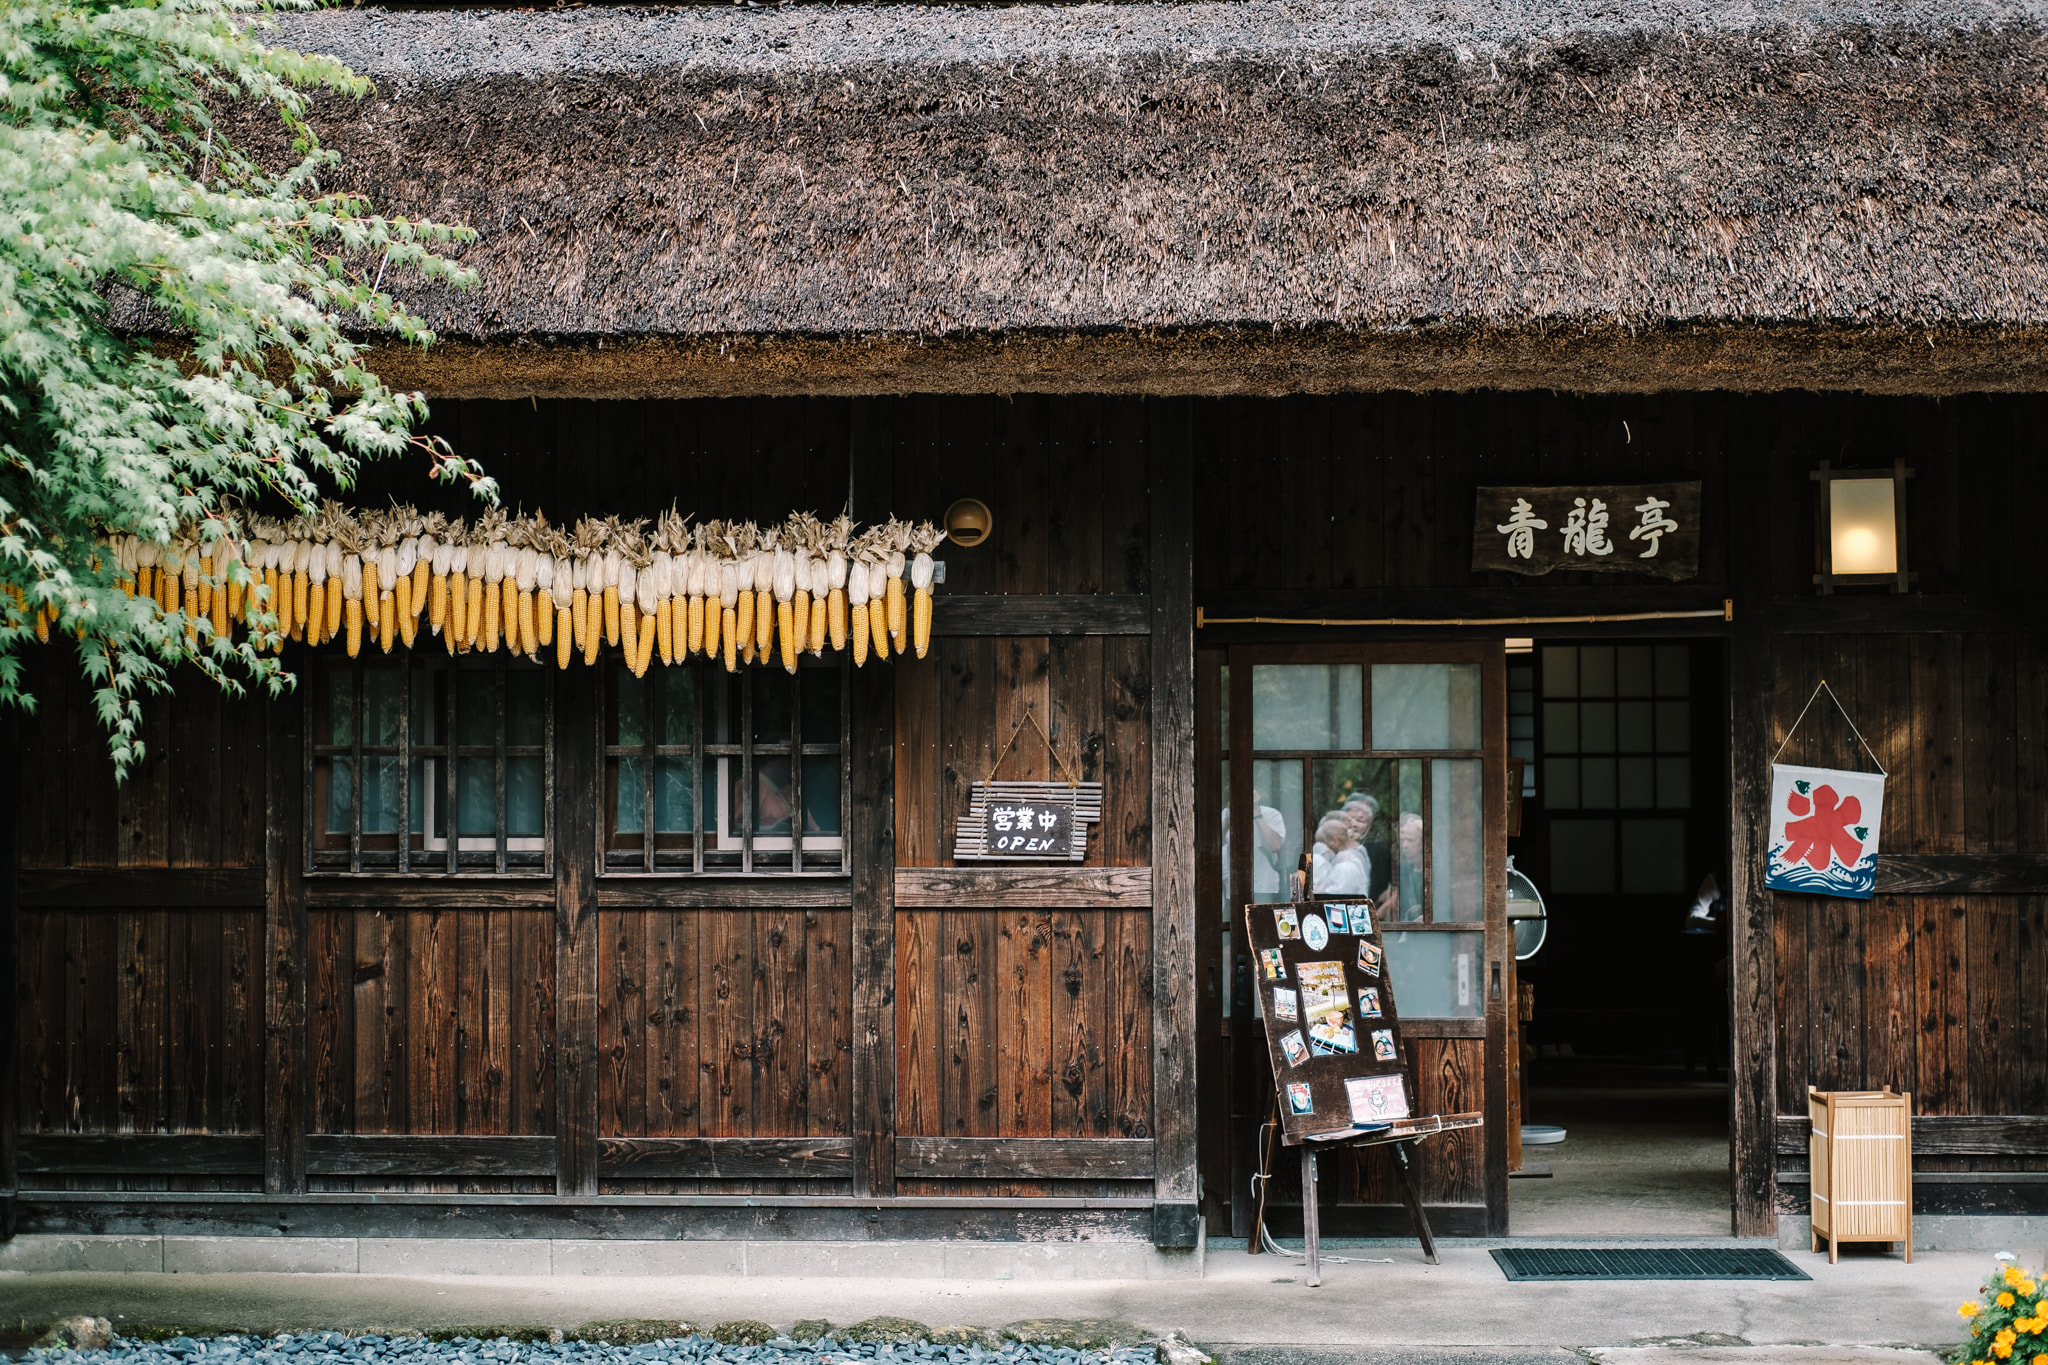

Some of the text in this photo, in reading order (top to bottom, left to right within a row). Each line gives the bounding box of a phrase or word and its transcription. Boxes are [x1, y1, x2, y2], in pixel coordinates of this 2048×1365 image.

[1497, 496, 1679, 559] 青龍亭
[993, 806, 1057, 832] 営業中
[1780, 784, 1864, 871] 氷
[997, 836, 1055, 851] OPEN
